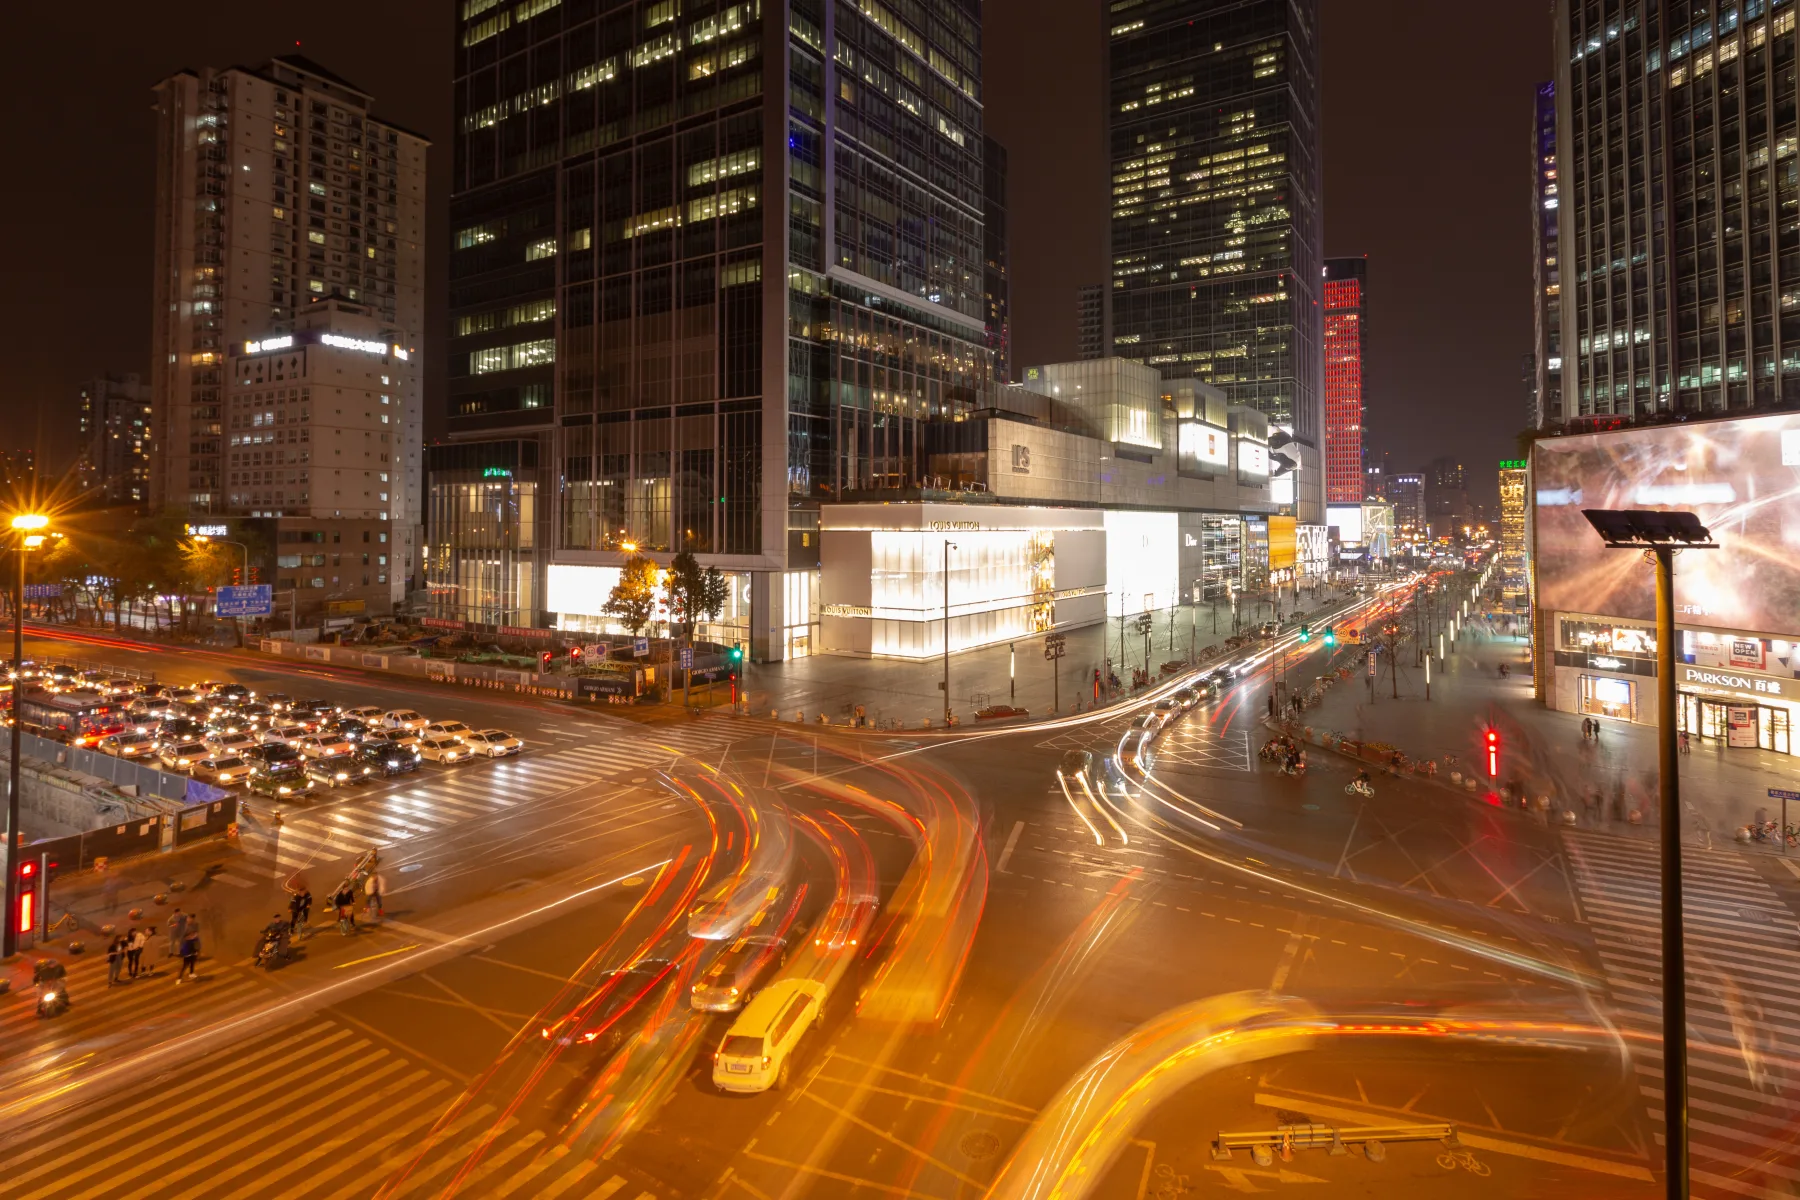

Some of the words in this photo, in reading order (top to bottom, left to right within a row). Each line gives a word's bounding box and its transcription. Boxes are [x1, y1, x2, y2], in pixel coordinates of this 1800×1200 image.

[929, 521, 950, 530] LOUIS
[951, 521, 980, 531] VUITTON
[842, 607, 869, 616] VUITTON
[1734, 642, 1752, 650] NEW
[1686, 669, 1752, 689] PARKSON
